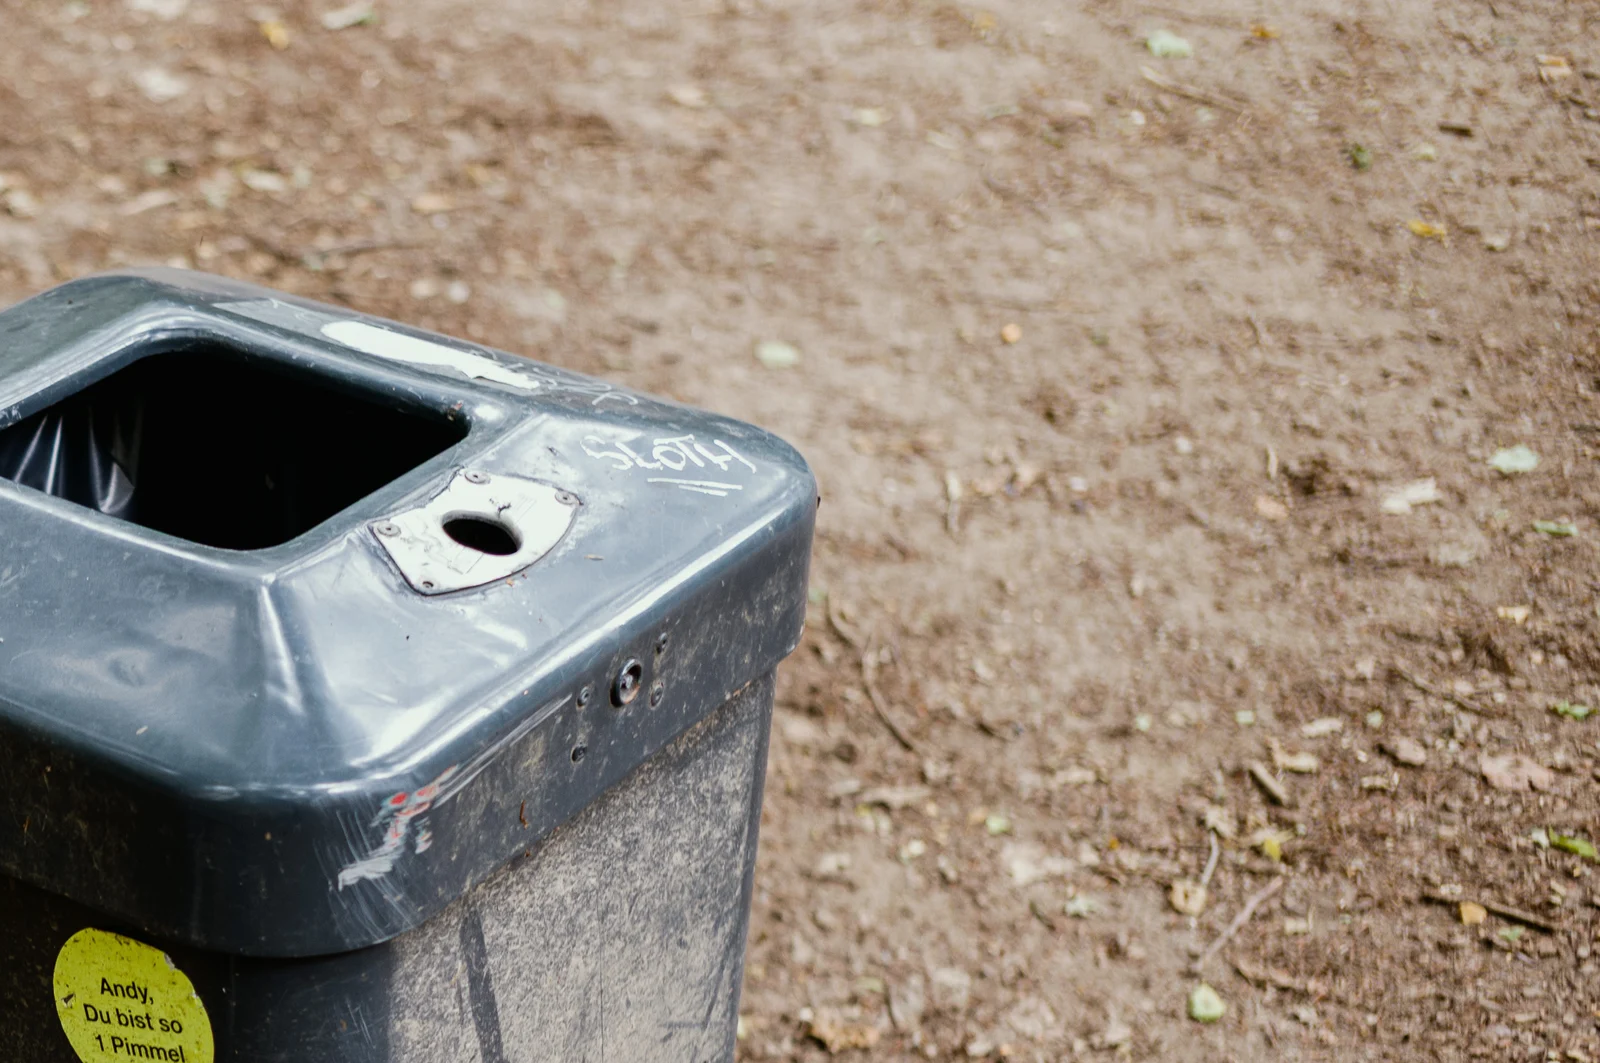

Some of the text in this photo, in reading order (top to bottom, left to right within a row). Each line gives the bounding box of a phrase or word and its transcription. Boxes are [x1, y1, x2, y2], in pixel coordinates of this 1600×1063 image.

[579, 433, 758, 475] SLOTH
[100, 977, 155, 1005] Andy,
[83, 1003, 184, 1034] Du bist so
[95, 1034, 186, 1063] 1 Pimmel
